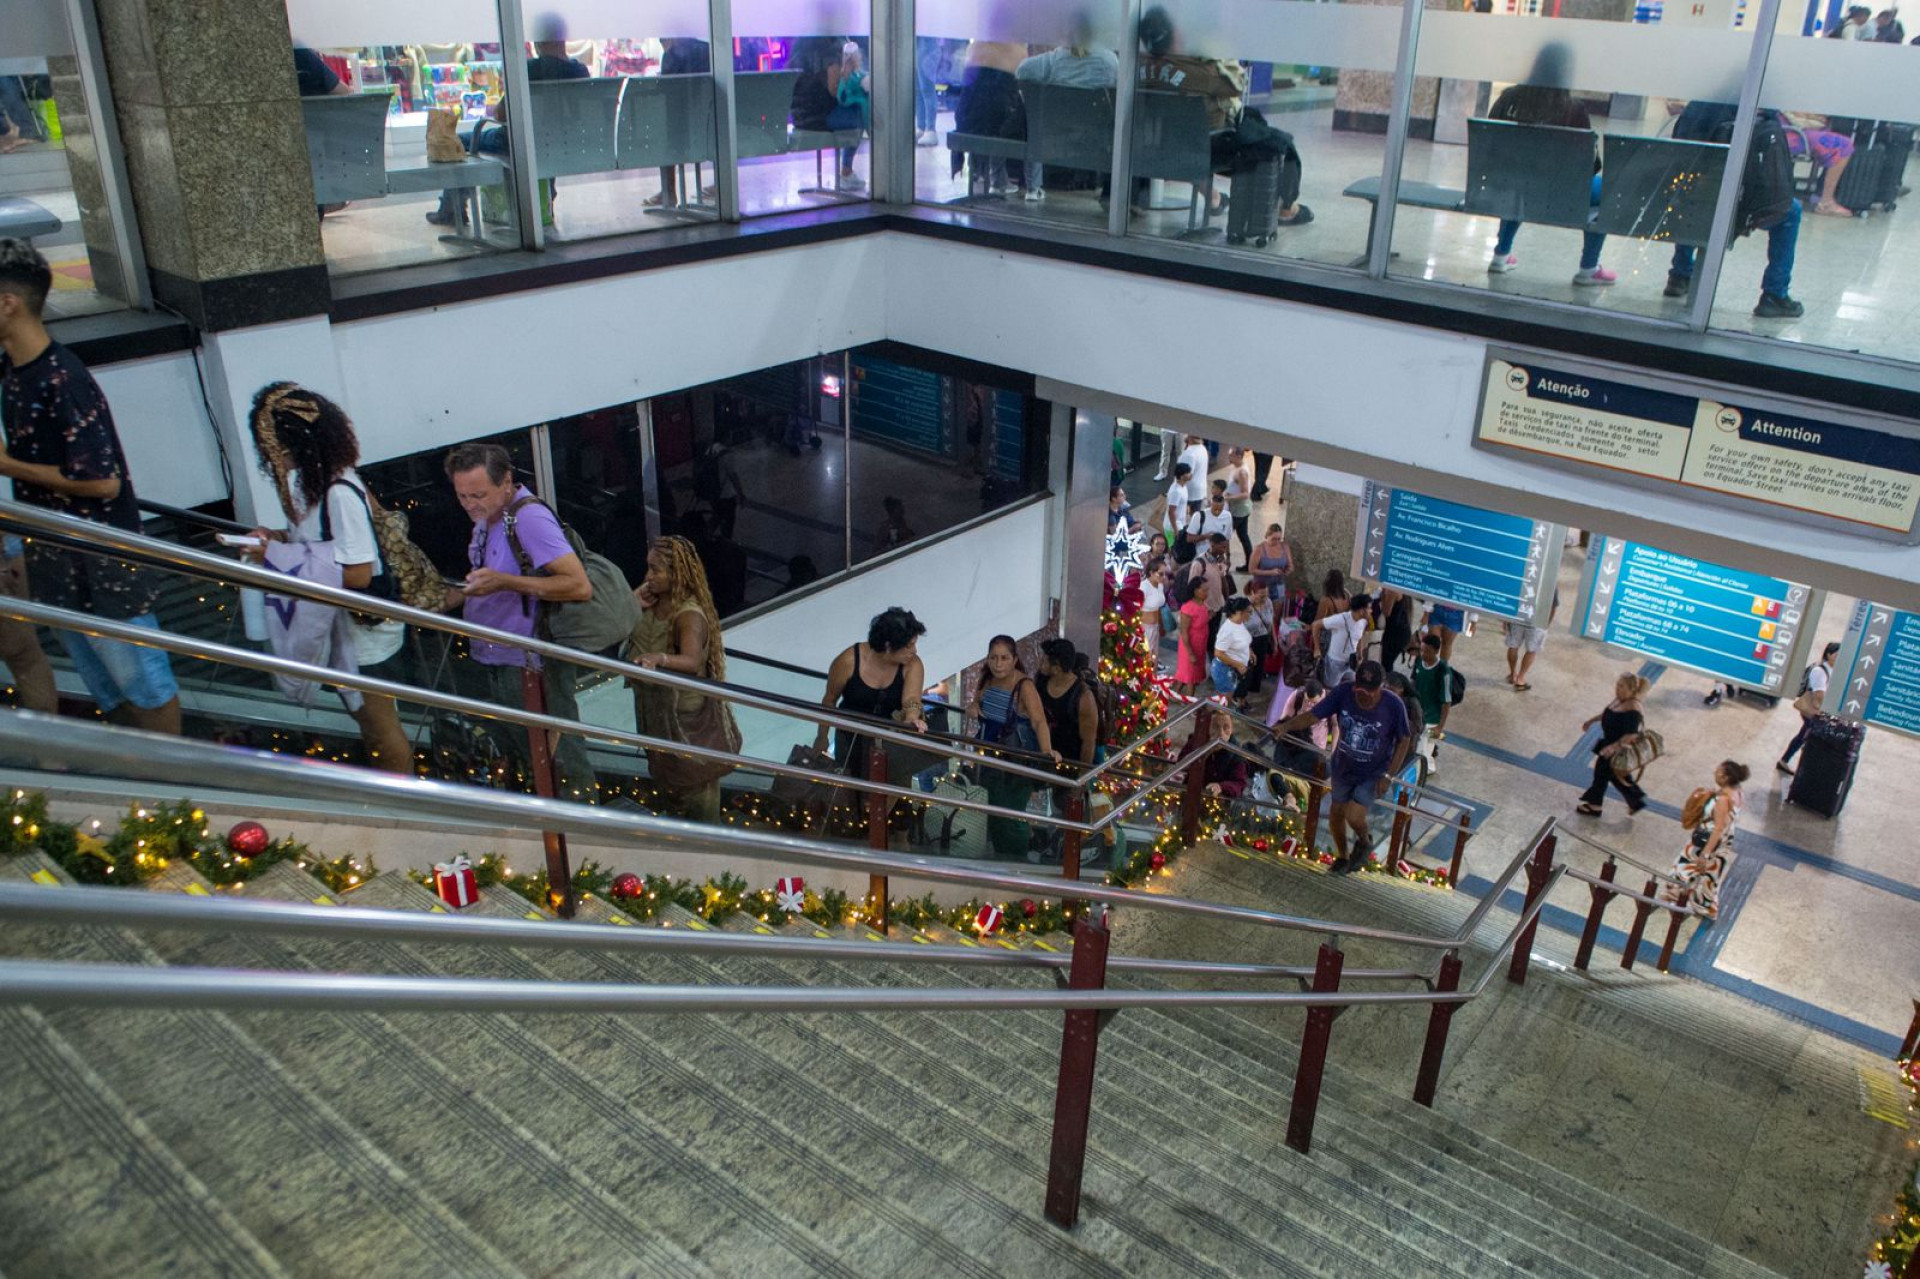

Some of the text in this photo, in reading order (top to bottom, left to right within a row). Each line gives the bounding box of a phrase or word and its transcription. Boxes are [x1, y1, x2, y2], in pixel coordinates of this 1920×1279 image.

[1537, 377, 1590, 399] Atenção
[1500, 409, 1510, 418] de
[1511, 412, 1542, 425] serviços
[1544, 418, 1554, 426] de
[1584, 426, 1609, 438] frente
[1611, 431, 1623, 441] do
[1624, 434, 1660, 448] terminal.
[1501, 401, 1663, 440] Para sua segurança, não aceite oferta
[1497, 425, 1507, 434] de
[1576, 442, 1591, 451] Rua
[1593, 445, 1630, 459] Equador.
[1524, 422, 1575, 439] credenciados
[1580, 434, 1615, 448] somente
[1621, 443, 1632, 451] no
[1637, 446, 1660, 457] setor
[1751, 419, 1821, 445] Attention
[1707, 453, 1908, 501] service offers on the departure area of the
[1709, 443, 1911, 492] For your own safety, don't accept any taxi
[1703, 470, 1785, 493] on Equador Street.
[1705, 461, 1904, 511] terminal. Save taxi services on arrivals floor,
[1407, 514, 1437, 528] Francisco
[1437, 522, 1462, 534] Bicalho
[1404, 534, 1437, 548] Rodrigues
[1437, 541, 1455, 553] Alves
[1391, 550, 1433, 567] Carregadores
[1388, 567, 1423, 584] Bilheterias
[1629, 566, 1668, 584] Embarque
[1624, 587, 1667, 606] Plataformas
[1619, 607, 1662, 626] Plataformas
[1615, 627, 1646, 642] Elevador
